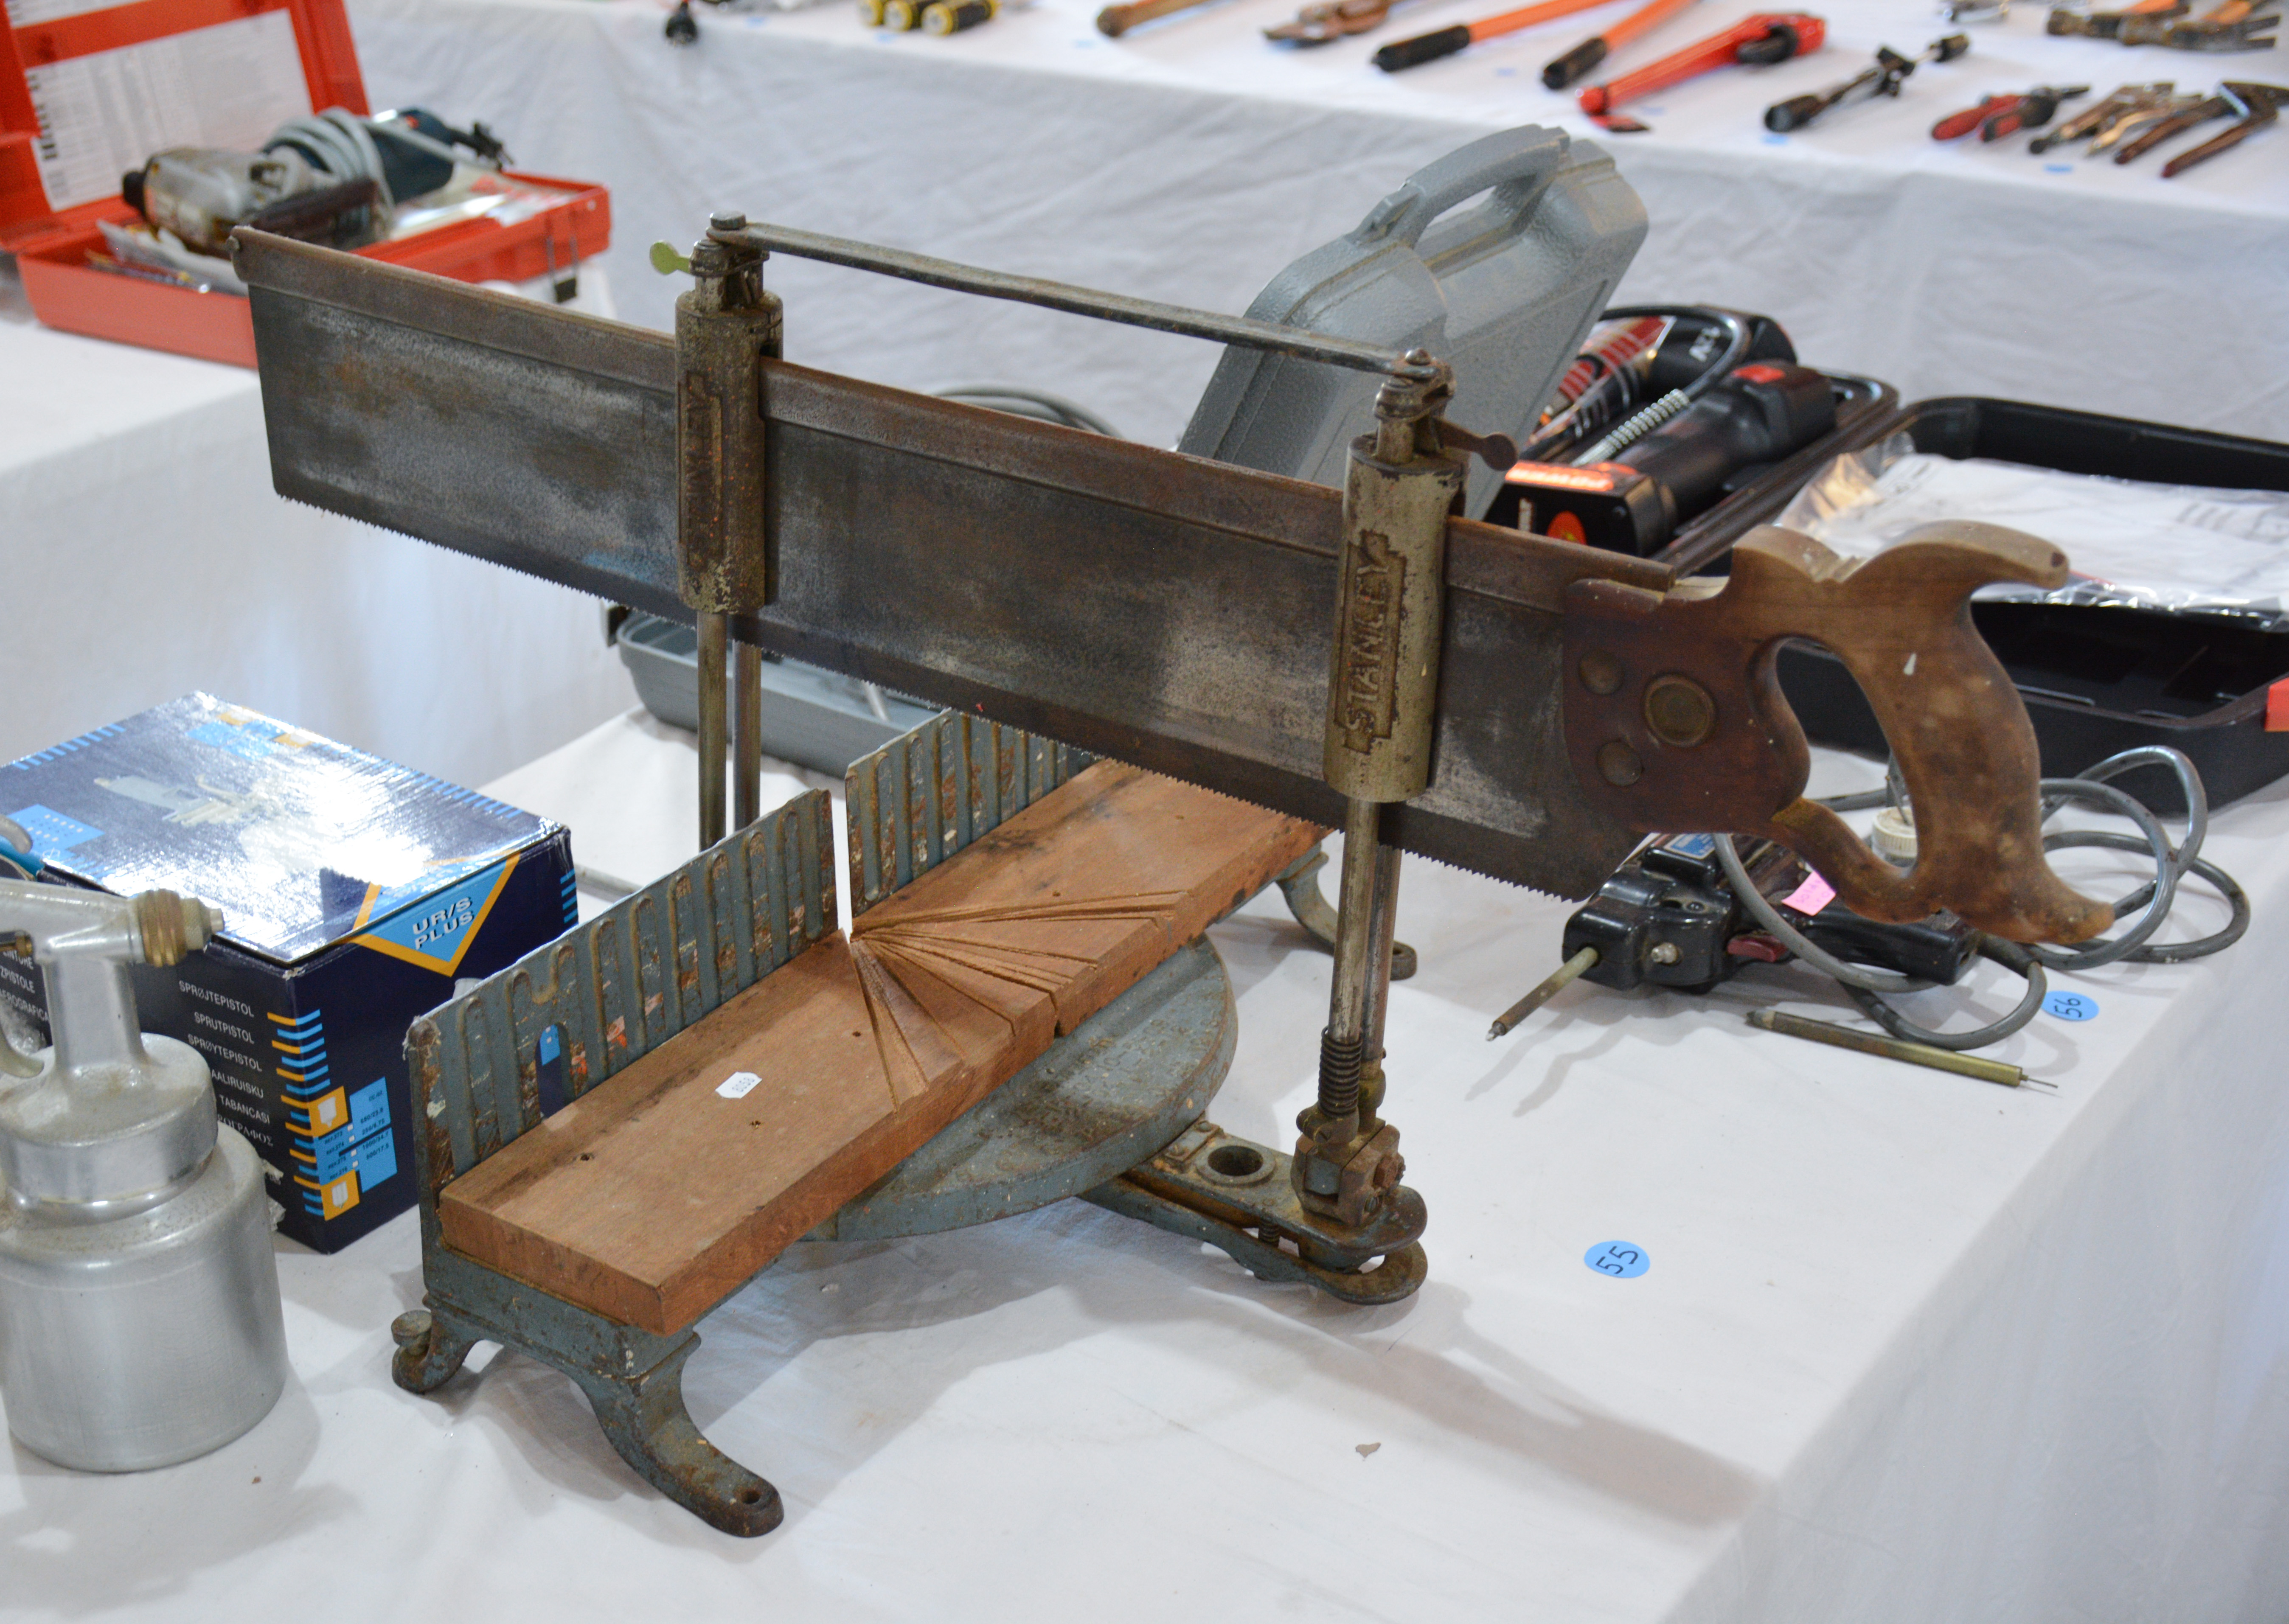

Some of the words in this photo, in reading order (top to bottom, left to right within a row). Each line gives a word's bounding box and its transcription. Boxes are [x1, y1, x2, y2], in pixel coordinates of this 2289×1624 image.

[1344, 551, 1389, 733] STANLEY
[413, 896, 472, 935] UR/S
[414, 910, 475, 950] PLUS
[179, 980, 255, 1018] SPRØJTEPISTOL
[2054, 998, 2083, 1018] 56
[194, 1012, 255, 1044] SPRUTPISTOL
[188, 1033, 263, 1072] SPRØYTEPISTOL
[212, 1069, 264, 1099] AALIRUISKU
[217, 1114, 274, 1147] ΡΟΓΡΑΦΟΣ
[1595, 1245, 1639, 1274] 55
